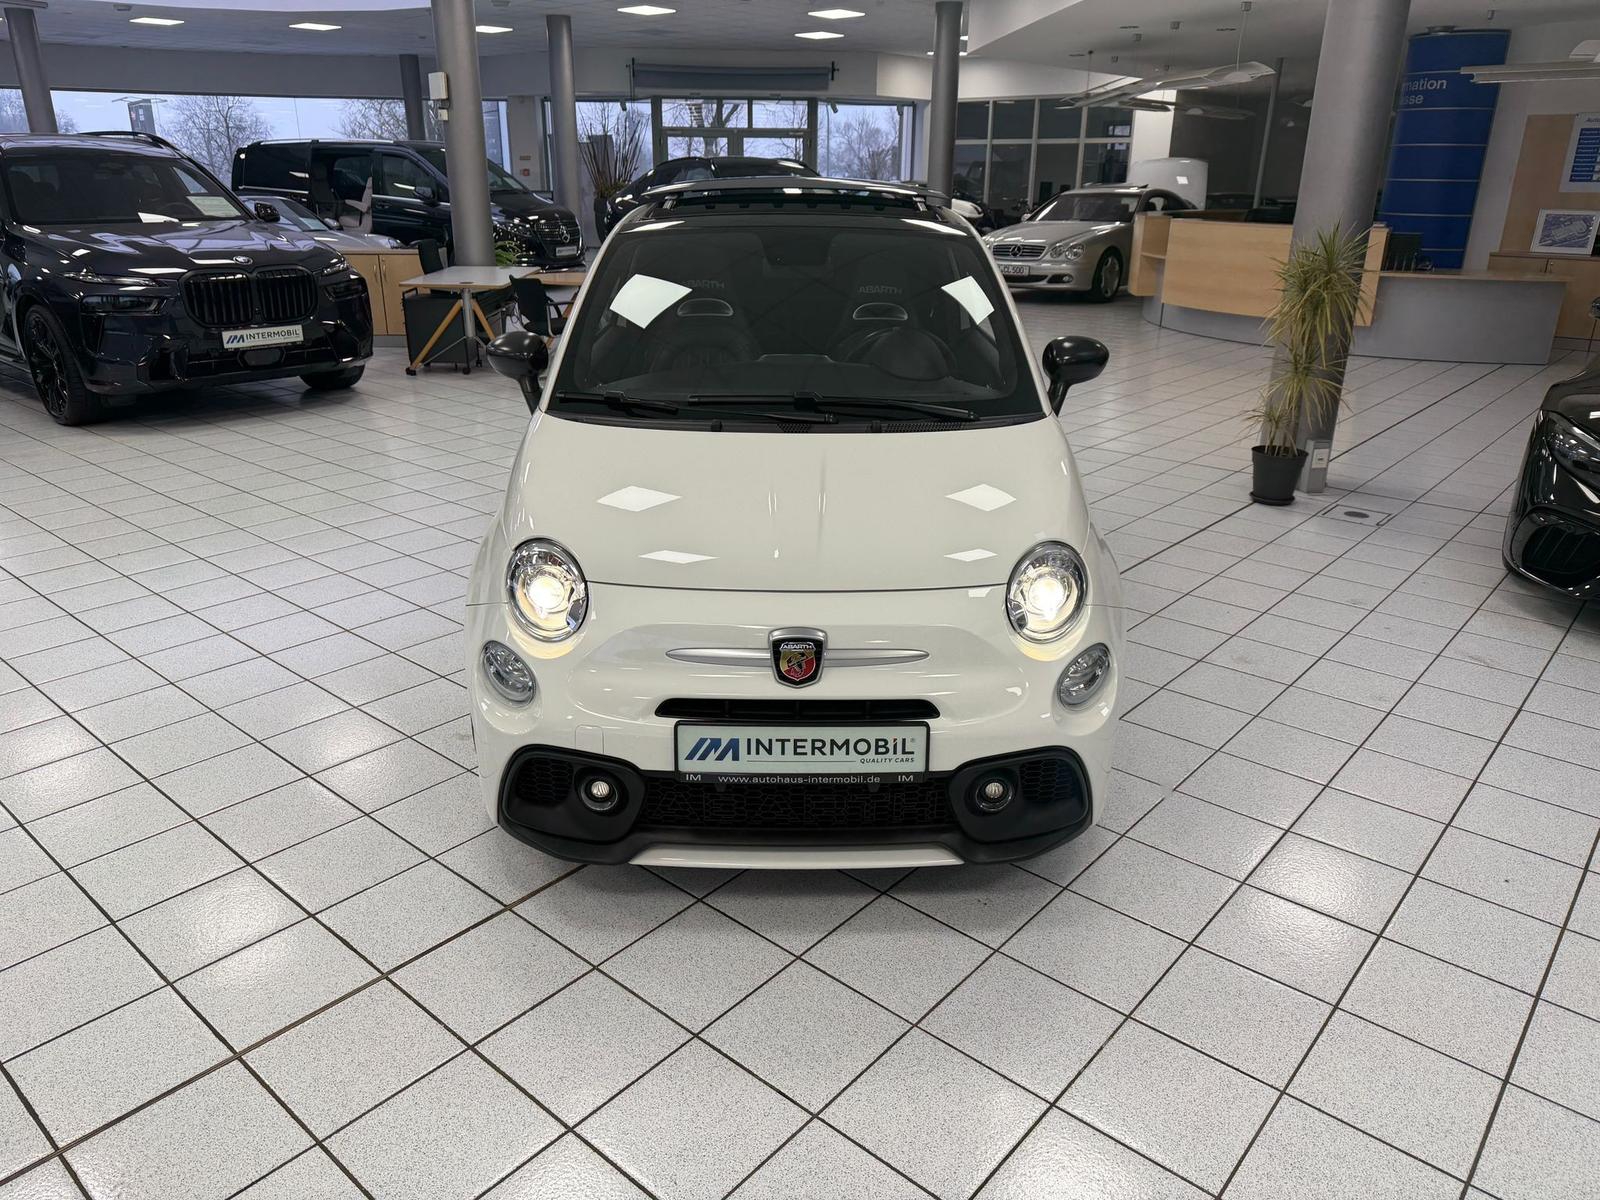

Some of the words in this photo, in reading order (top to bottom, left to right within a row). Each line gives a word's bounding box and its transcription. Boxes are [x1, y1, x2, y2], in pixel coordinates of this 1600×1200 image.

[857, 285, 902, 294] ABARTH
[859, 757, 893, 765] QUALITY
[685, 773, 702, 781] IM
[718, 774, 881, 784] www.autohaus-intermobil.de
[897, 774, 914, 782] IM
